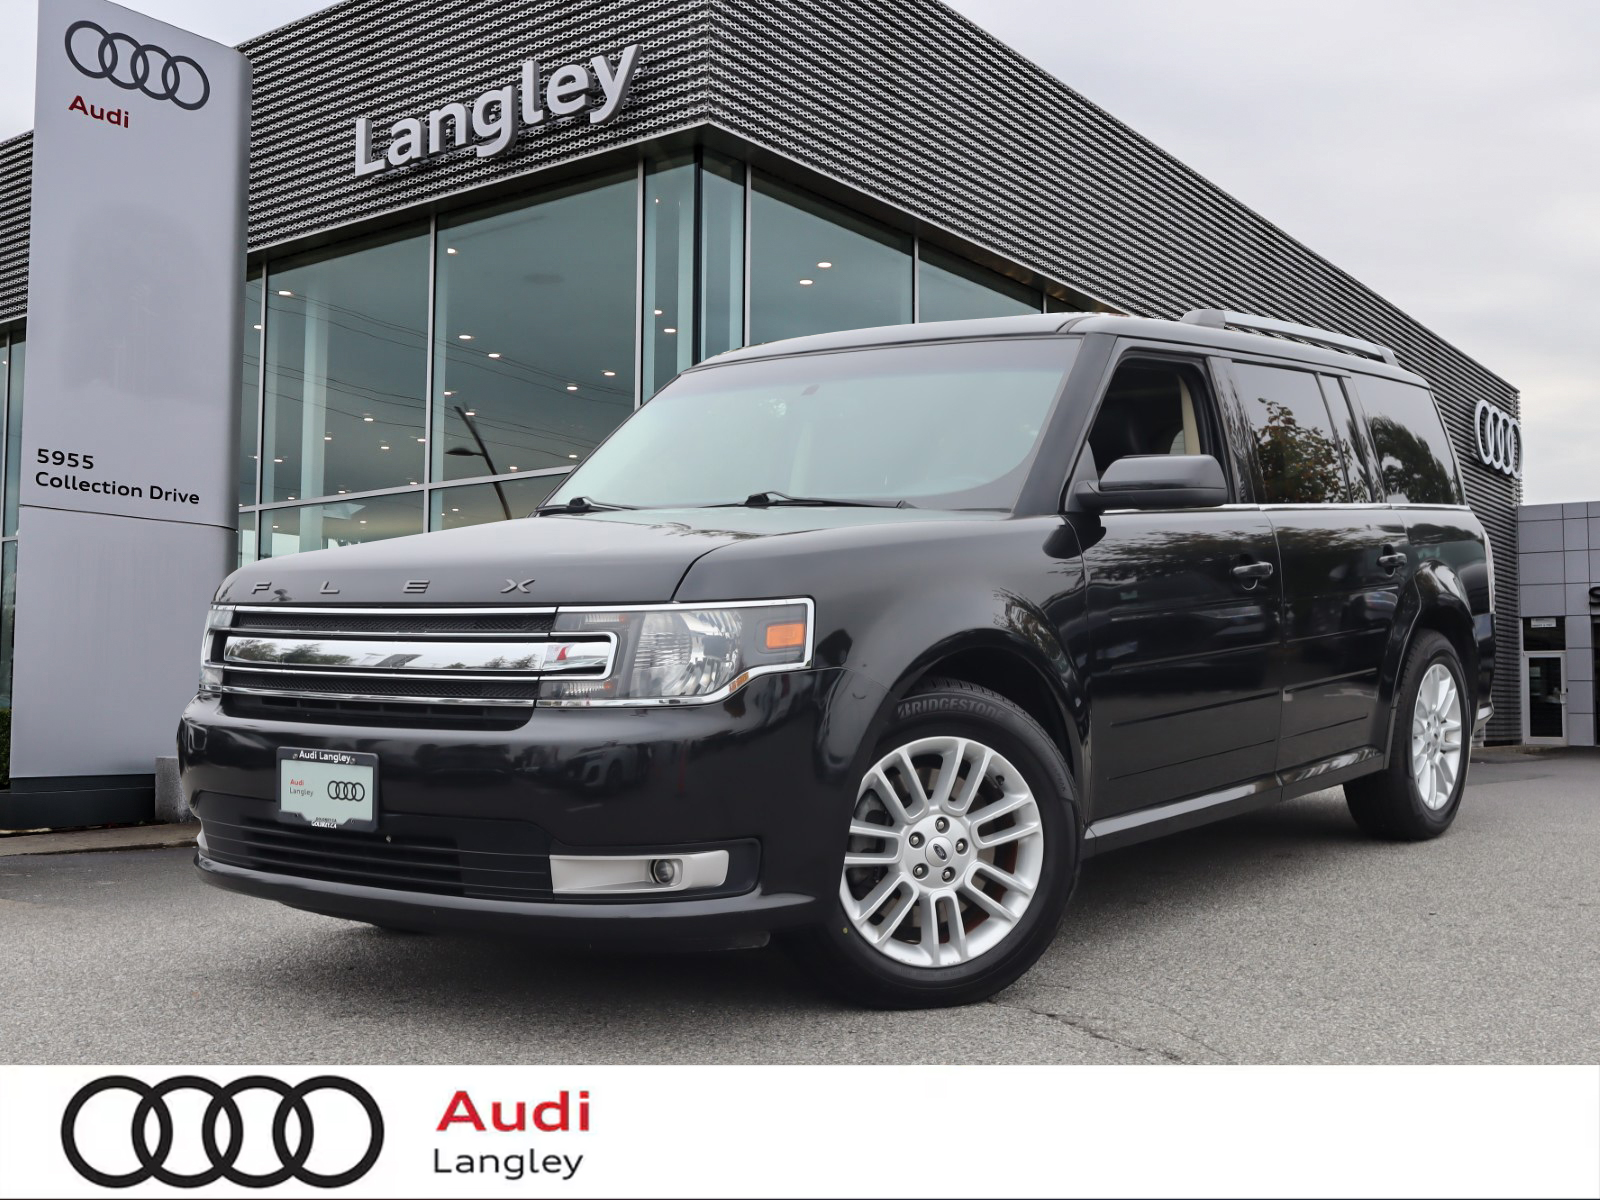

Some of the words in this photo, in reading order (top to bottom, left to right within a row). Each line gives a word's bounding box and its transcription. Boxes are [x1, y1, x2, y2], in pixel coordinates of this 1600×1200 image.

[68, 95, 129, 128] Audi
[354, 44, 641, 177] Langley
[37, 448, 94, 470] 5955
[35, 471, 143, 498] Collection
[149, 485, 200, 504] Drive
[251, 578, 536, 594] FLEX
[897, 697, 1005, 719] BRIDGESTONE
[299, 750, 317, 760] Audi
[319, 751, 351, 764] Langley
[289, 787, 313, 797] Langley
[290, 778, 304, 786] Audi
